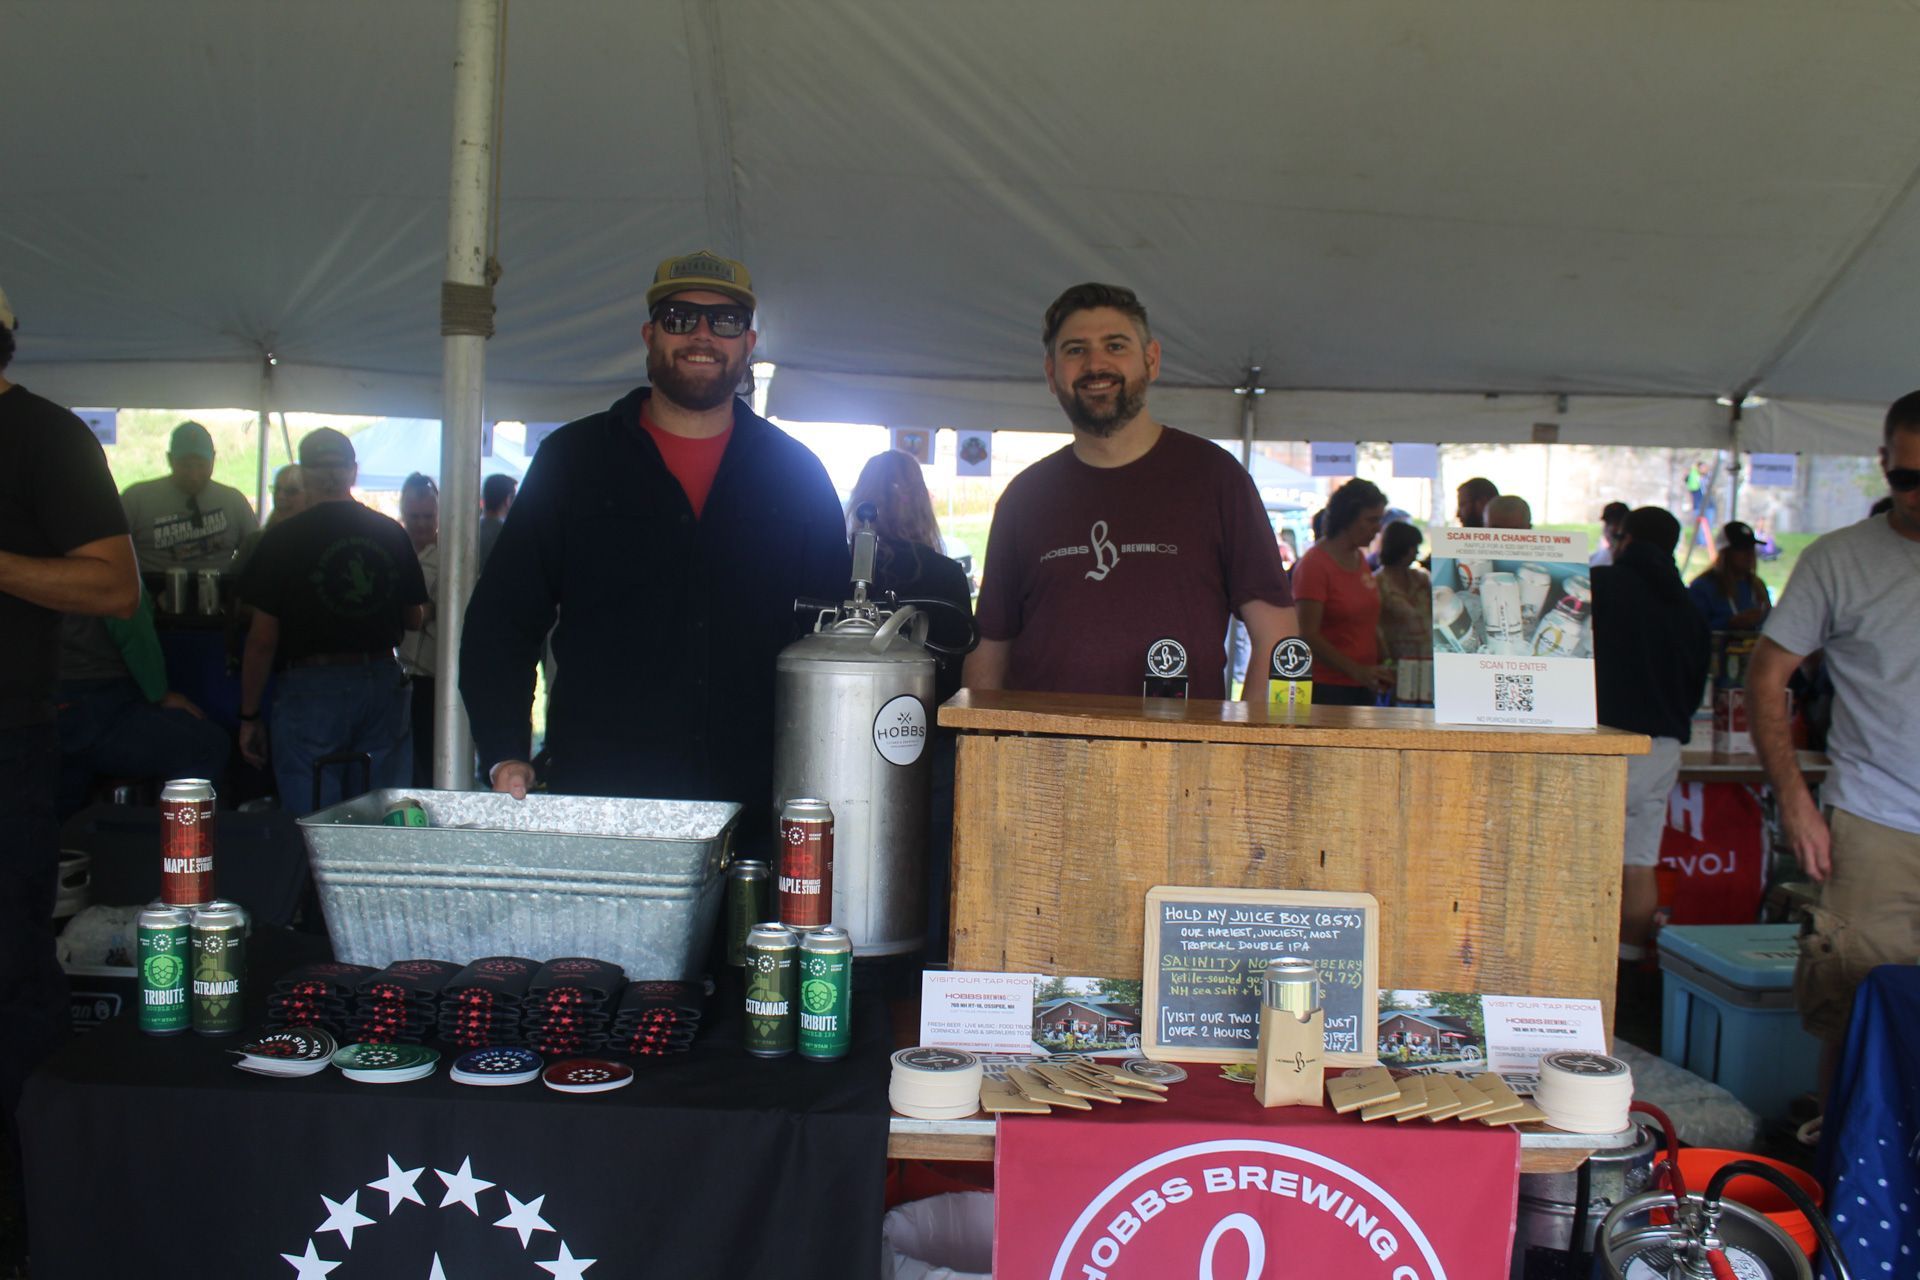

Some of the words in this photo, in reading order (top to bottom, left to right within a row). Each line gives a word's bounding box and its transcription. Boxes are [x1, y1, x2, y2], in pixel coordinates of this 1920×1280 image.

[1447, 532, 1471, 541] SCAN
[1473, 533, 1491, 541] FOR
[1493, 534, 1500, 542] A
[1502, 534, 1537, 543] CHANCE
[1539, 535, 1551, 543] TO
[1552, 536, 1571, 544] WIN
[1040, 545, 1089, 563] HOBBS
[1121, 544, 1156, 553] BREWING
[1480, 660, 1503, 669] SCAN
[1505, 662, 1517, 670] TO
[1519, 663, 1548, 671] ENTER
[878, 726, 925, 740] HOBBS
[163, 857, 196, 874] MAPLE
[802, 885, 821, 894] STOUT
[1165, 907, 1202, 921] HOLD
[1207, 908, 1228, 925] MY
[1230, 911, 1275, 924] JUICE
[1280, 912, 1311, 926] BOX
[1181, 928, 1204, 937] OUR
[1309, 930, 1341, 939] MOST
[1181, 940, 1235, 951] TROPICAL
[1239, 941, 1284, 950] DOUBLE
[1288, 942, 1311, 952] IPA
[1161, 955, 1241, 972] SALINITY
[193, 980, 239, 996] CITRANADE
[1170, 986, 1188, 996] NH
[1192, 987, 1212, 995] sea
[144, 988, 185, 1005] TRIBUTE
[745, 998, 789, 1016] CITRANADE
[801, 1012, 838, 1031] TRIBUTE
[1167, 1011, 1195, 1024] VISIT
[1200, 1013, 1225, 1024] OUR
[1228, 1014, 1252, 1024] TWO
[1324, 1017, 1352, 1029] JUST
[1168, 1026, 1198, 1037] OVER
[1201, 1027, 1210, 1037] 2
[1214, 1027, 1251, 1039] HOURS
[259, 1034, 292, 1044] 14TH
[292, 1037, 308, 1054] STAR
[470, 1051, 499, 1062] 14TH
[505, 1051, 533, 1062] STAR
[1082, 1176, 1194, 1280] HOBBS
[1203, 1165, 1398, 1261] BREWING
